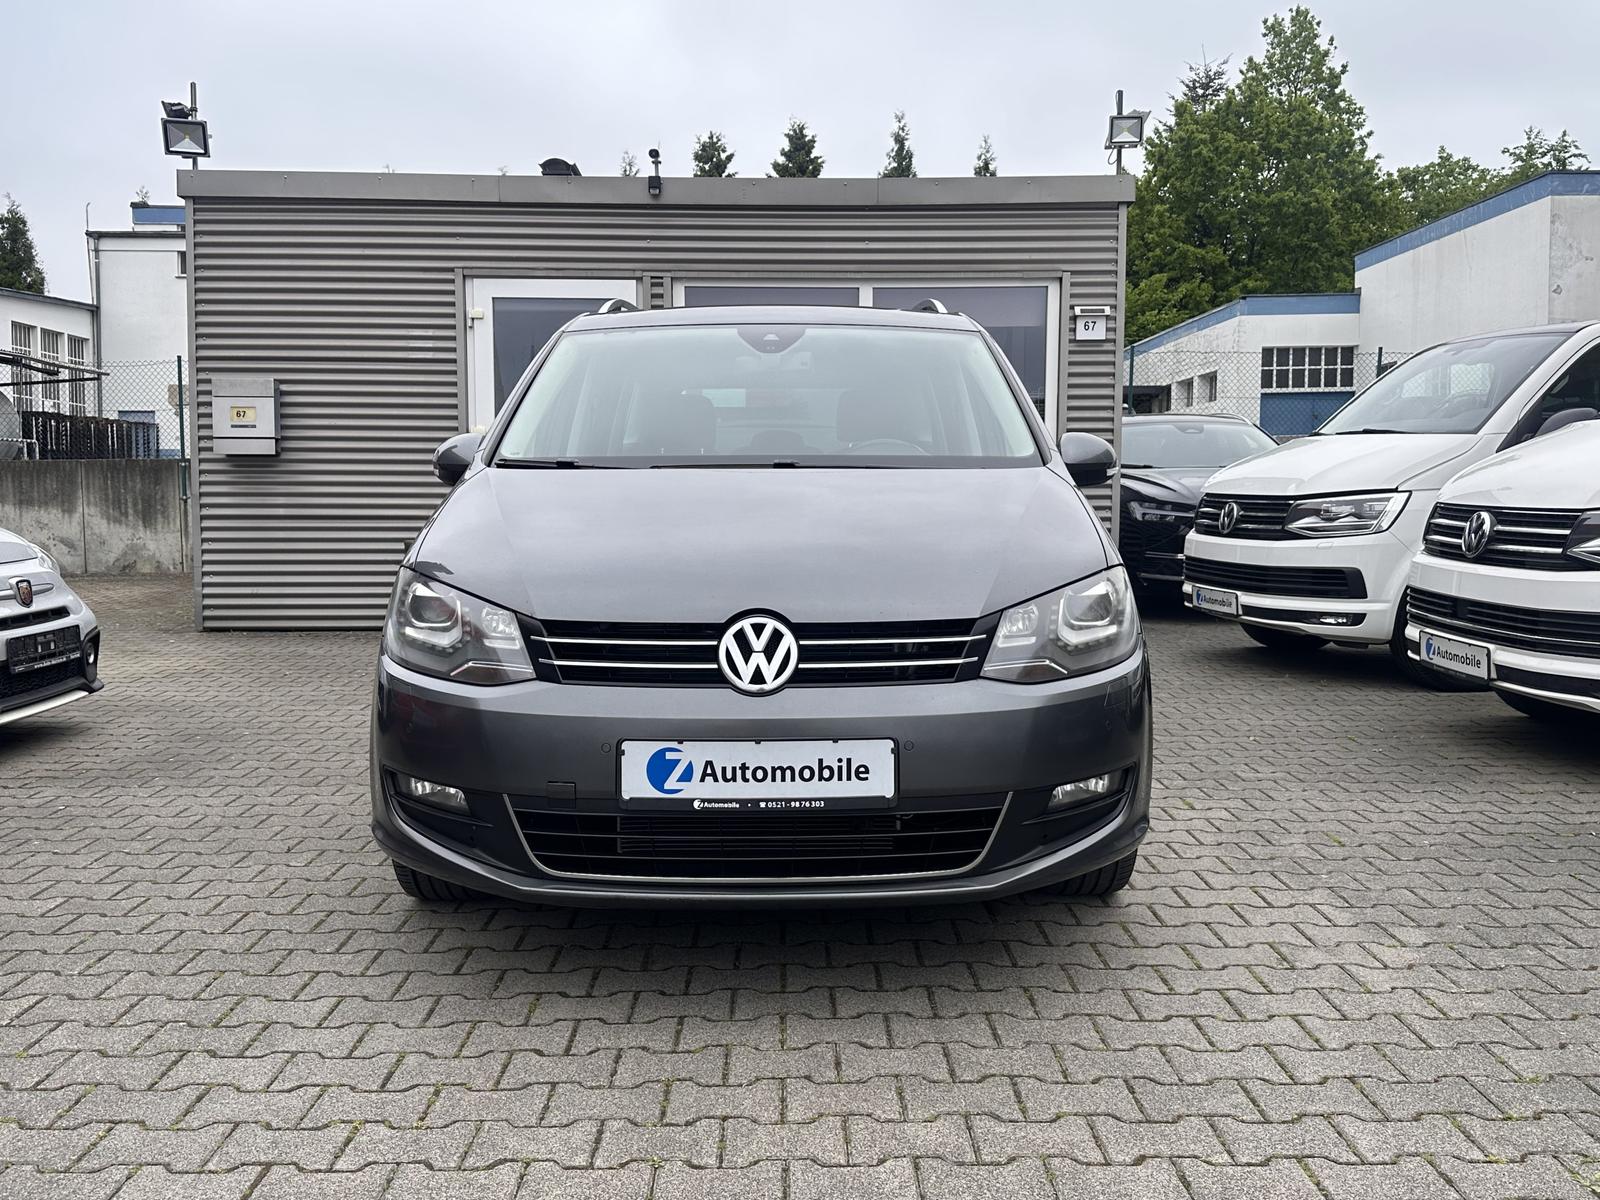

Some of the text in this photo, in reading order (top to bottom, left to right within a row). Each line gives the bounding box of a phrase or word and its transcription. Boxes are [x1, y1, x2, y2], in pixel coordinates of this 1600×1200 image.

[1083, 320, 1097, 332] 67
[236, 410, 246, 418] 67
[1437, 645, 1481, 669] Automobile
[699, 758, 870, 783] Automobile
